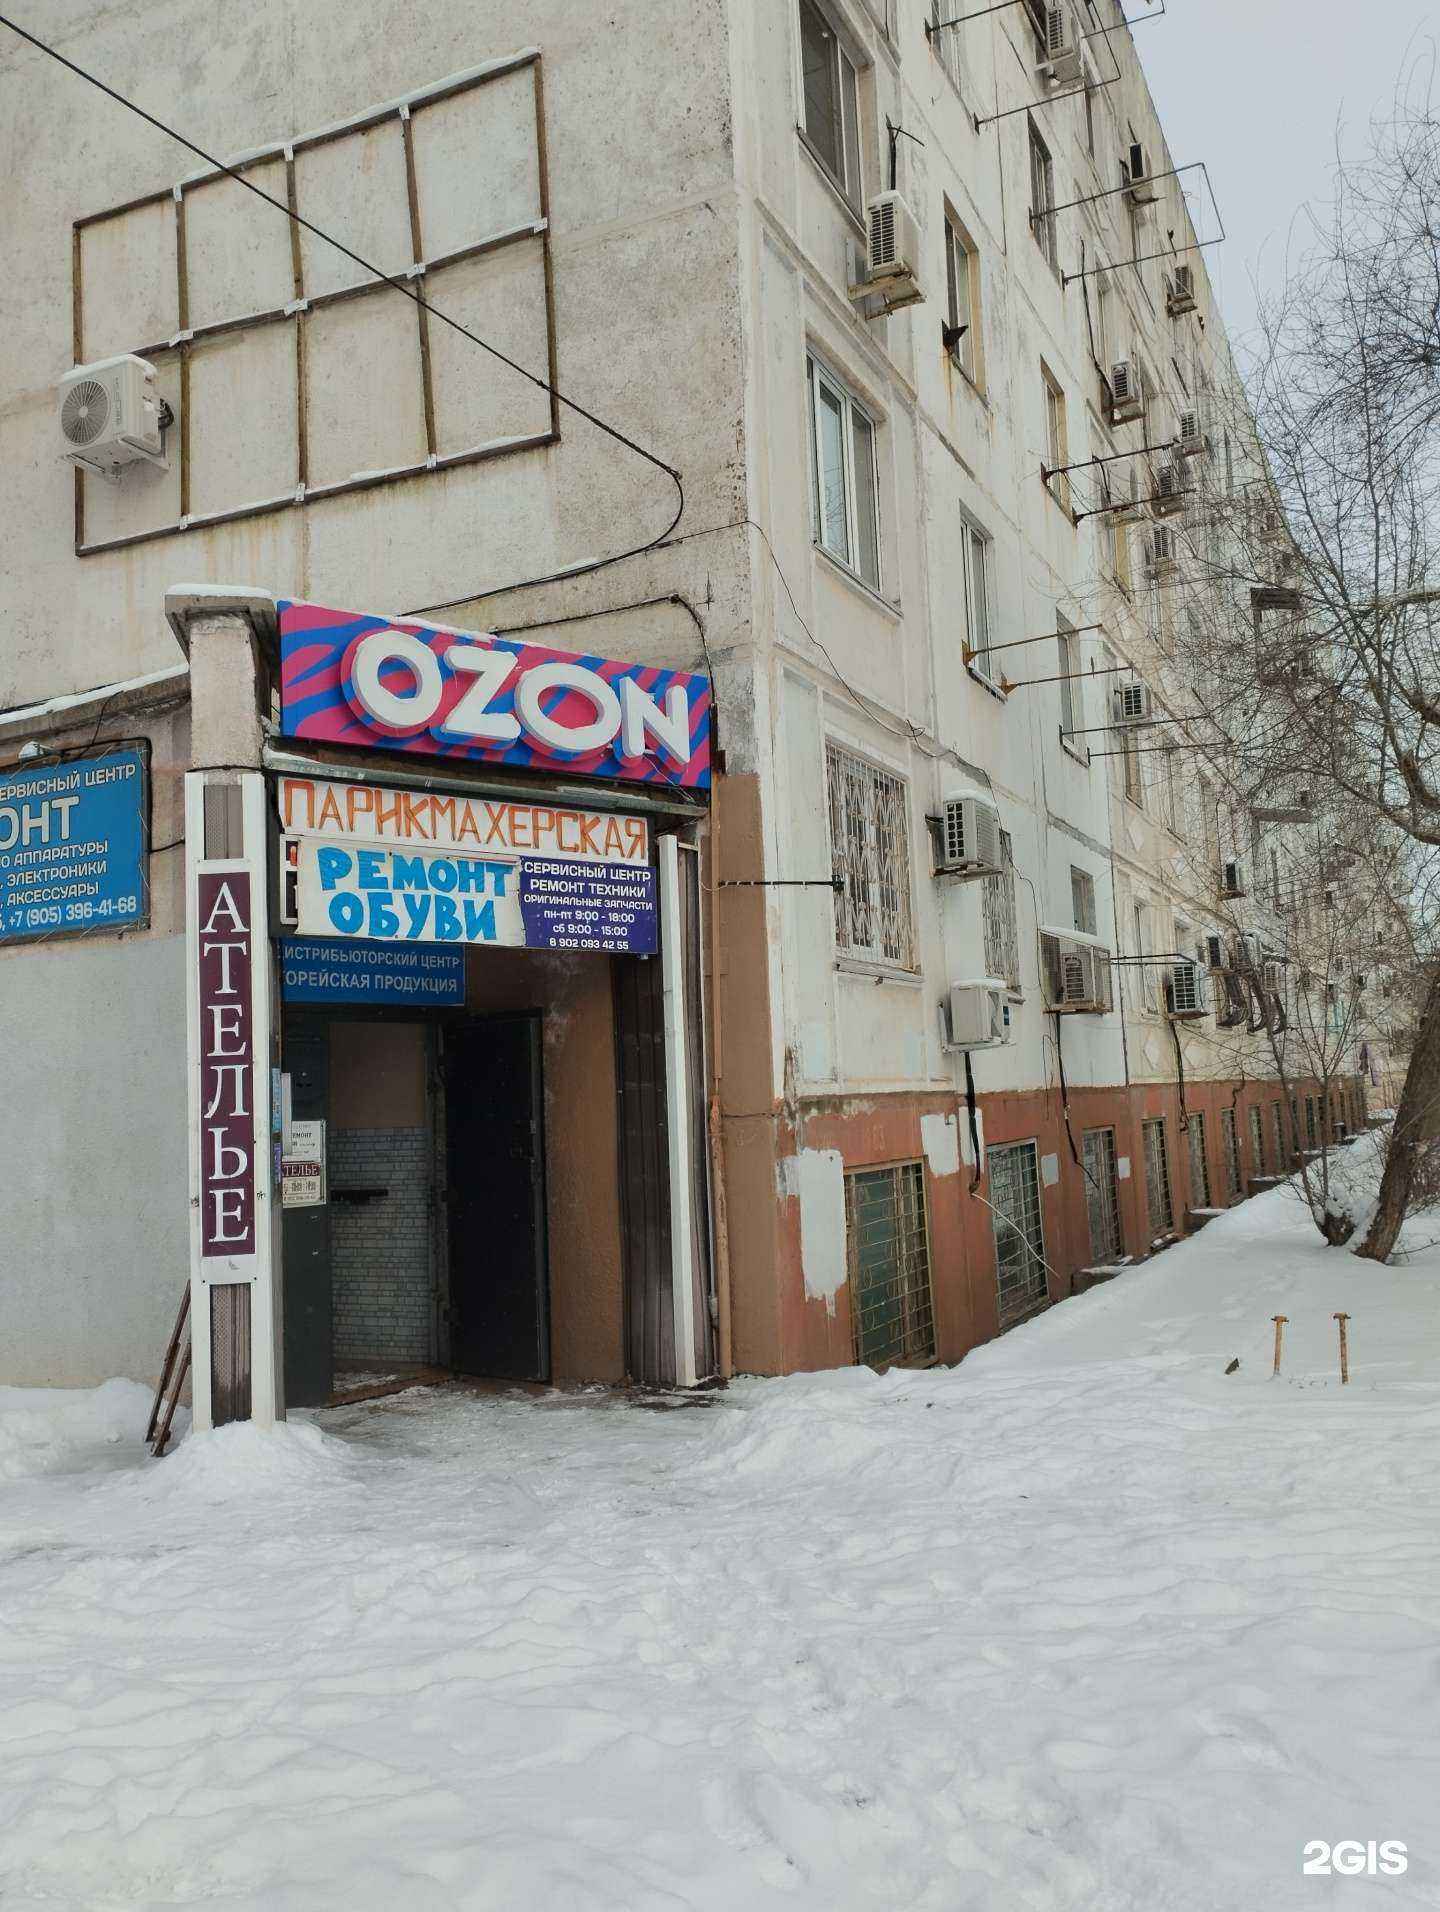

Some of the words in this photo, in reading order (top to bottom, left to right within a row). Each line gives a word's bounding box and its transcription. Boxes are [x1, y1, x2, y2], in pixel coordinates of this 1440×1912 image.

[351, 629, 691, 765] OZON
[0, 770, 80, 801] ЕРВИСНЫЙ
[85, 763, 136, 786] ЦЕНТР
[0, 796, 80, 850] ОНТ
[283, 779, 647, 861] ПАРИКМАХЕРСКАЯ
[13, 840, 108, 866] АППАРАТУРЫ
[7, 860, 107, 887] ЭЛЕКТРОНИКИ
[317, 846, 514, 898] РЕМОНТ
[524, 862, 607, 879] СЕРВИСНЫЙ
[610, 869, 651, 882] ЦЕНТР
[7, 882, 99, 906] АКСЕССУАРЫ
[530, 879, 585, 893] РЕМОНТ
[588, 883, 646, 898] ТЕХНИКИ
[9, 911, 23, 927] +7
[26, 906, 62, 928] (905)
[65, 896, 137, 921] 396-41-68
[524, 894, 602, 908] ОРИГИНАЛЬНЫЕ
[604, 899, 653, 910] ЗАПЧАСТИ
[328, 891, 497, 941] ОБУВИ
[544, 910, 572, 920] пн-пт
[575, 910, 598, 920] 9:00
[608, 912, 635, 923] 18:00
[553, 923, 565, 933] сб
[568, 924, 591, 934] 9:00
[601, 926, 628, 936] 15:00
[549, 938, 557, 946] 8
[559, 938, 579, 948] 902
[581, 939, 600, 948] 093
[602, 940, 616, 949] 42
[617, 941, 629, 950] 55
[283, 945, 417, 967] ИСТРИБЬЮТОРСКИЙ
[421, 955, 459, 970] ЦЕНТР
[283, 968, 370, 989] ОРЕЙСКАЯ
[374, 974, 457, 994] ПРОДУКЦИЯ
[199, 880, 251, 1243] АТЕЛЬЕ
[282, 1164, 319, 1177] ТЕЛЬЕ
